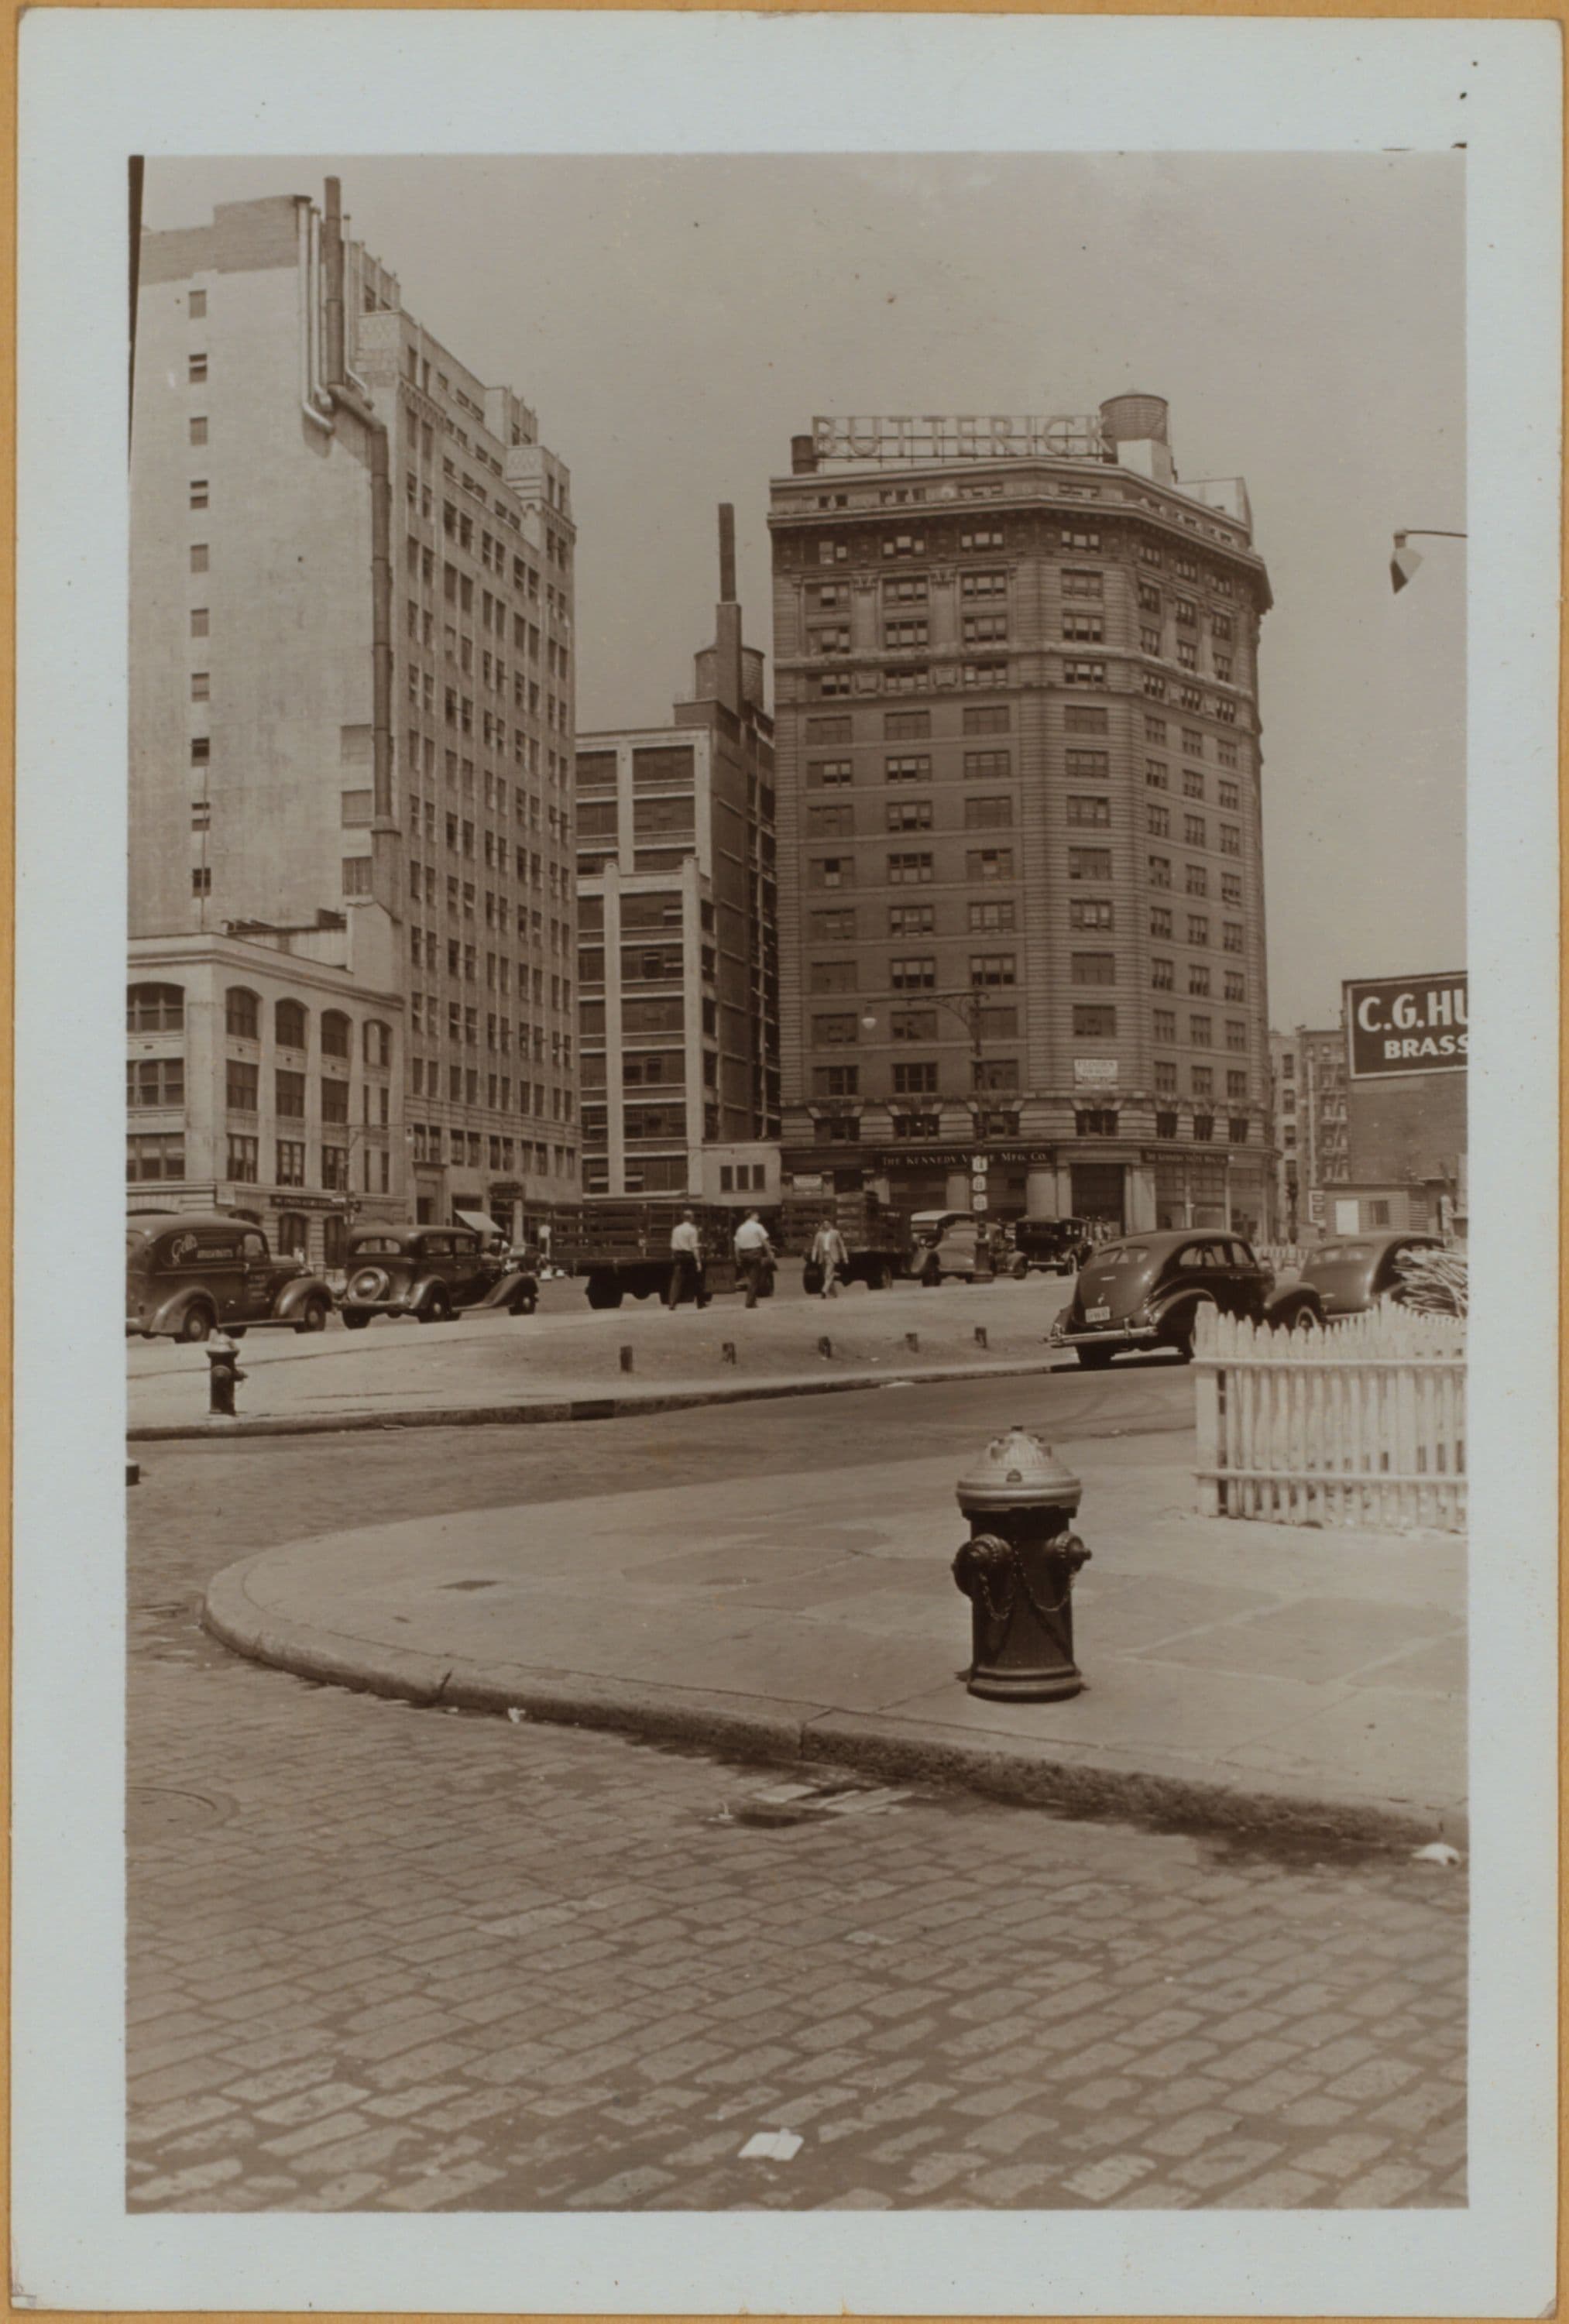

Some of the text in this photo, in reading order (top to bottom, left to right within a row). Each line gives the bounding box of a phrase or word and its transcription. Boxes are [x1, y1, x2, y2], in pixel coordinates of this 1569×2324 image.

[812, 417, 1115, 456] BUTTERICK
[1384, 1034, 1468, 1059] BRASS
[883, 1156, 900, 1165] THE
[906, 1155, 956, 1165] KENNEDY
